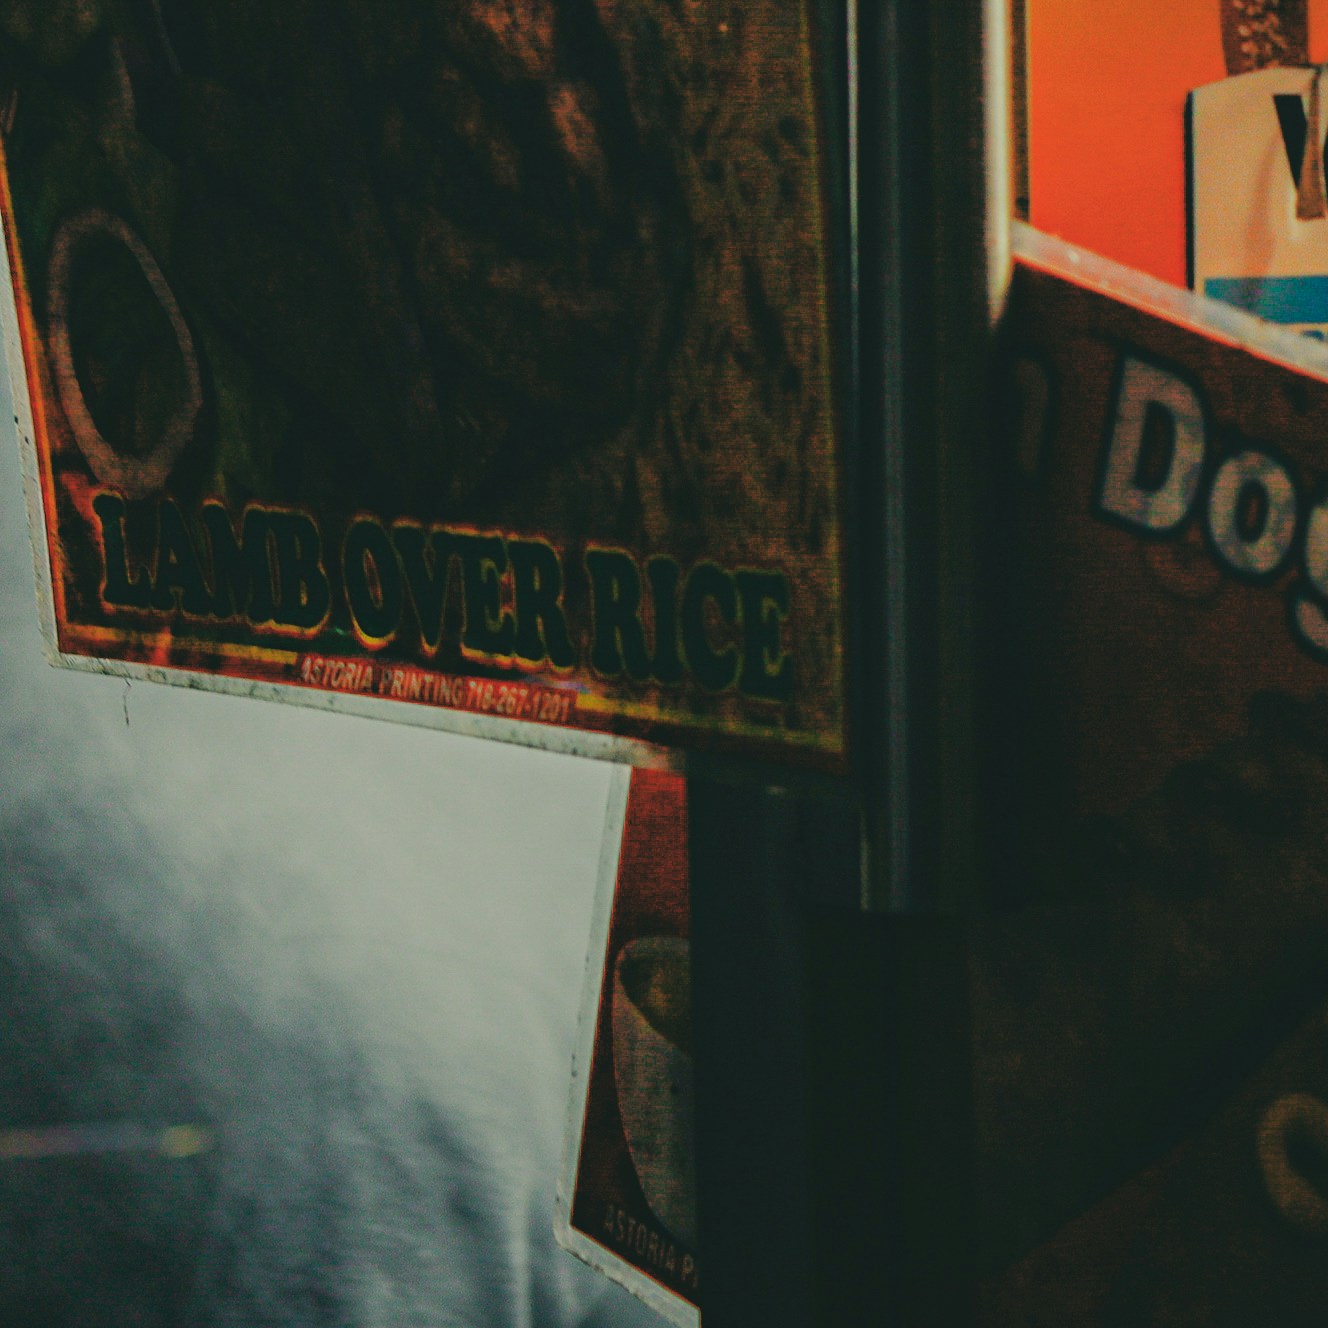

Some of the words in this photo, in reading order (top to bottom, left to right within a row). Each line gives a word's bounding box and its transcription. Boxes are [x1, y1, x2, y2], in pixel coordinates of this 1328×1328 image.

[92, 490, 330, 638] LAMB
[340, 512, 575, 675] OVER
[584, 544, 796, 702] RICE
[301, 654, 374, 690] ASTORIA
[379, 668, 464, 706] PRINTING
